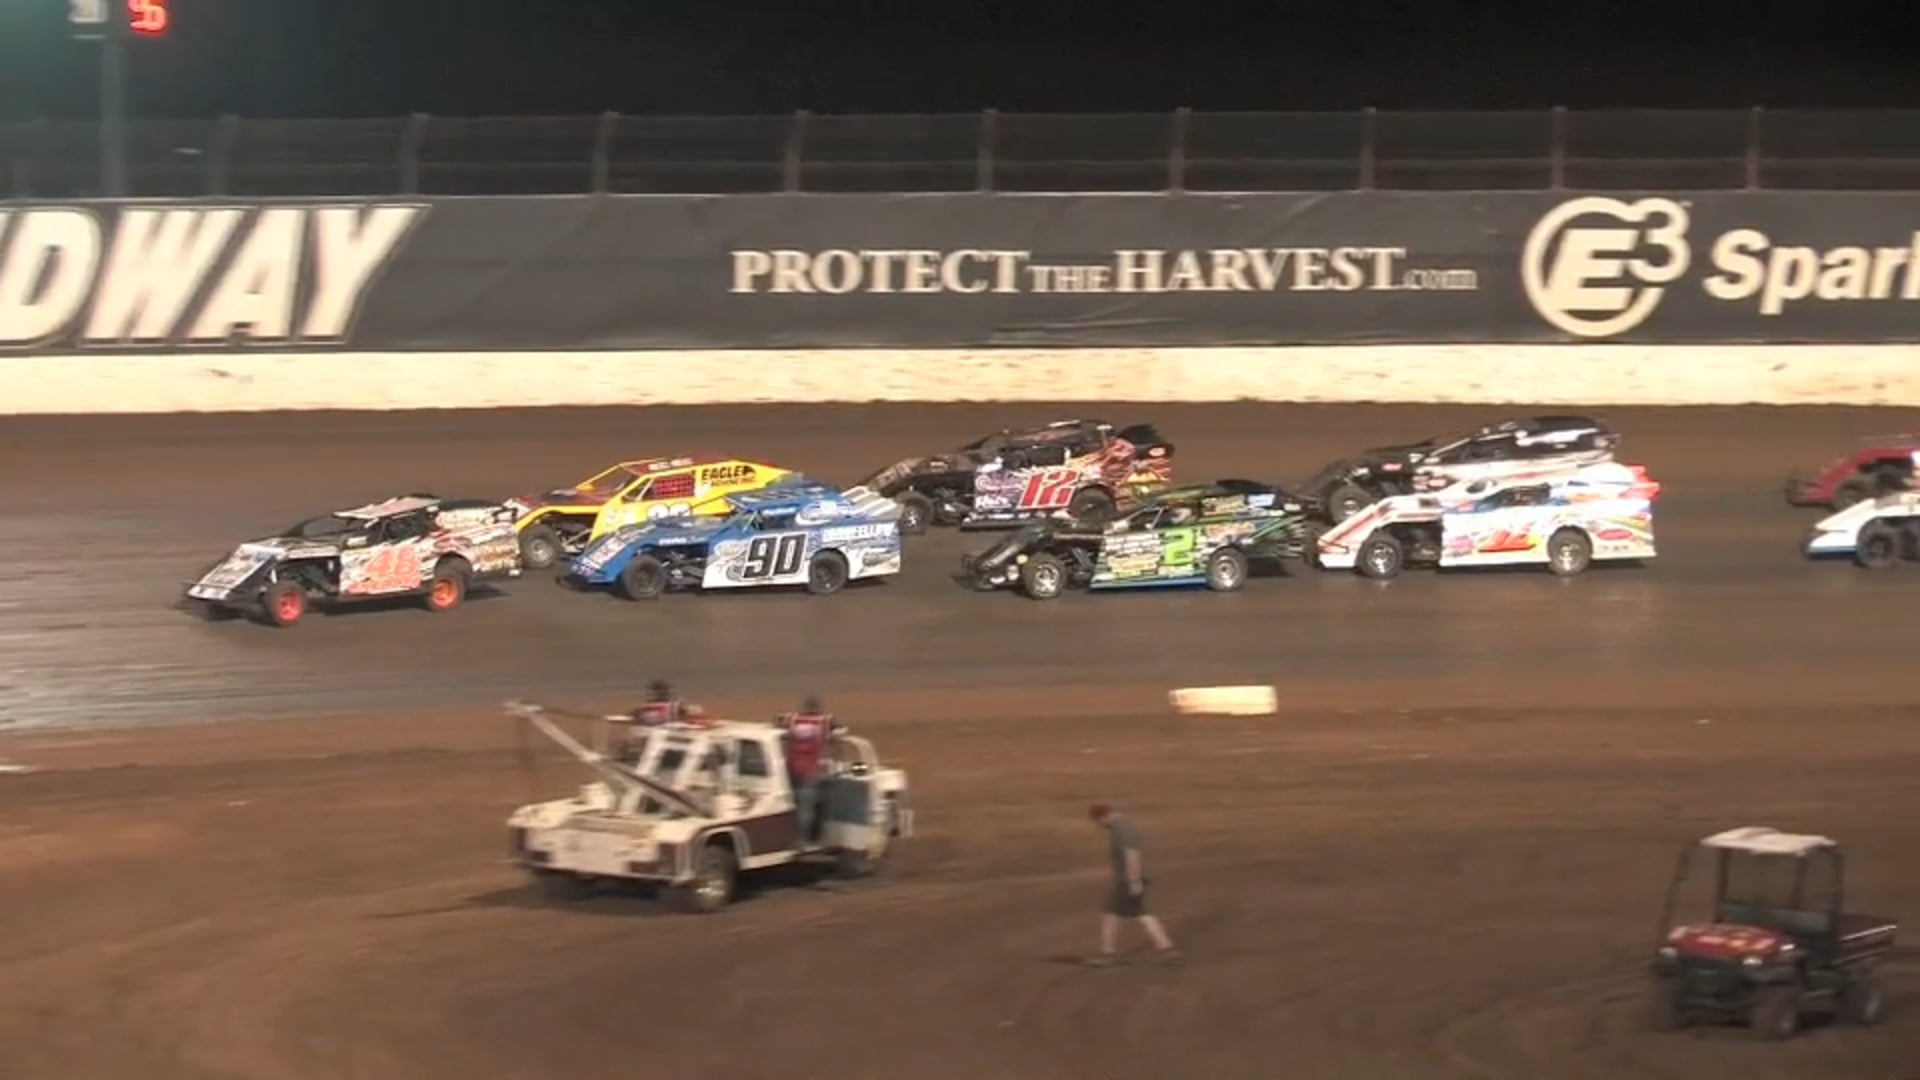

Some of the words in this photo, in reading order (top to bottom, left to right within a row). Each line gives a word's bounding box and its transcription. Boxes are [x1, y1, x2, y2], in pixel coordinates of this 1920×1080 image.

[0, 206, 424, 344] DWAY
[701, 465, 744, 481] EAGLE
[1018, 468, 1080, 510] 12
[743, 533, 808, 579] 90
[1162, 526, 1196, 567] 2
